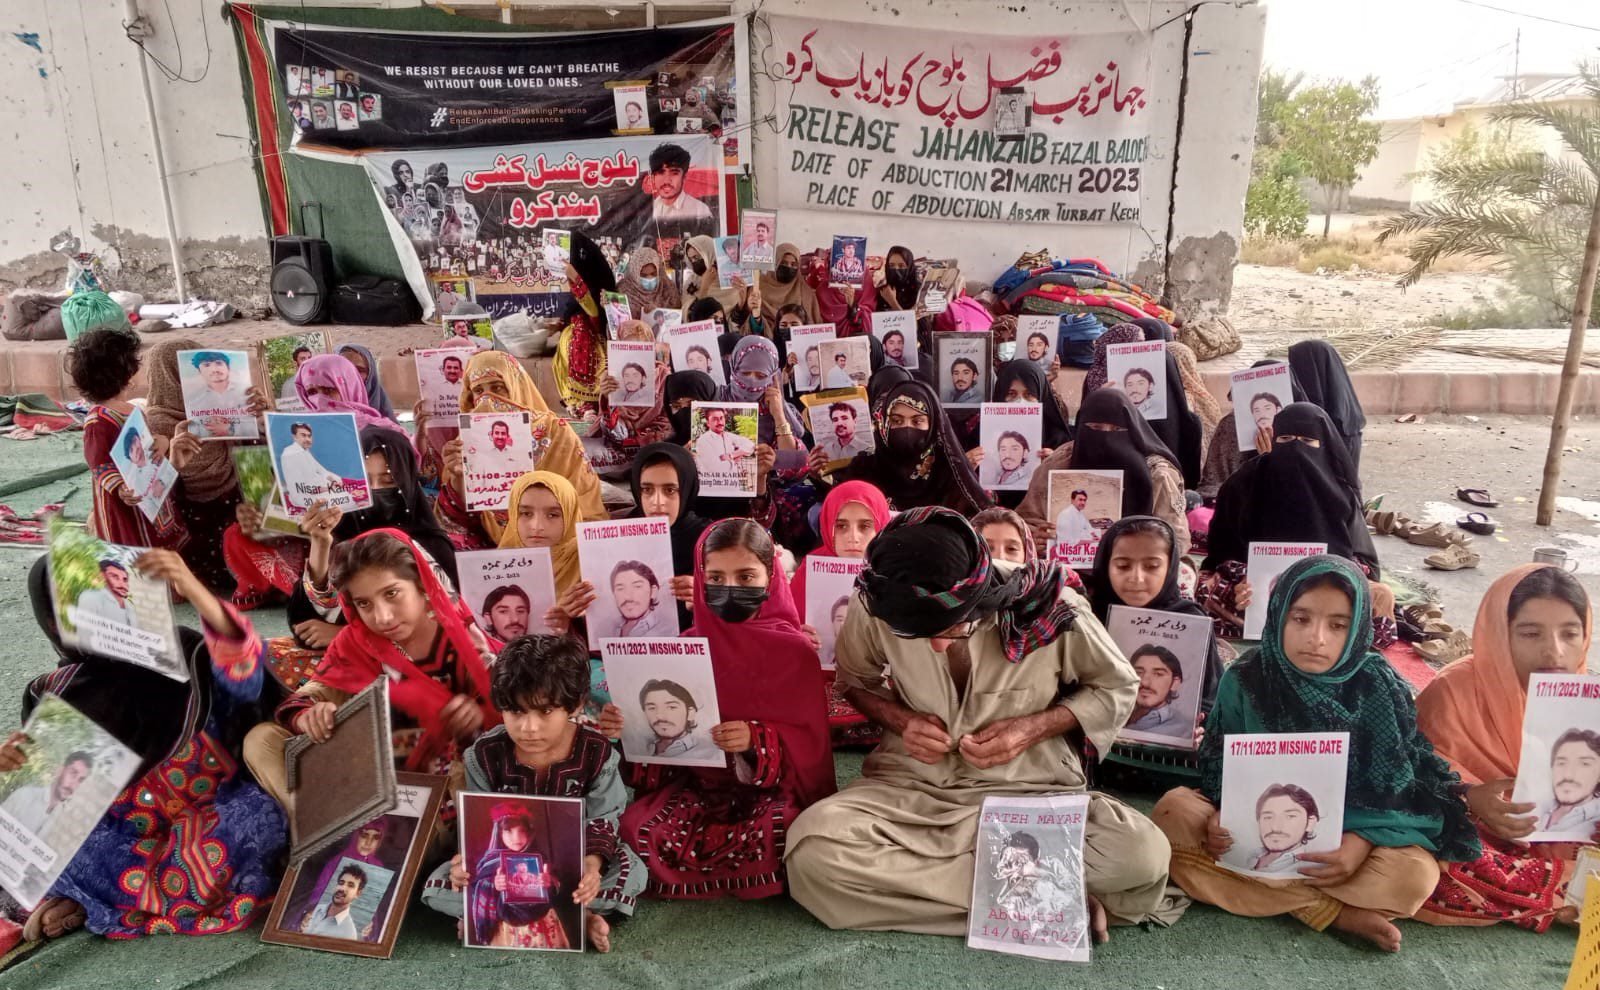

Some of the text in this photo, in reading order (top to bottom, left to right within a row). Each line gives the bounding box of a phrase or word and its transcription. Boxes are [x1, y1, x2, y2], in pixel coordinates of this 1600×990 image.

[785, 28, 818, 84] کرو
[384, 63, 620, 76] WE RESIST BECAUSE WE CAN'T BREATHE
[424, 77, 583, 89] WITHOUT OUR LOVED ONES.
[815, 51, 896, 108] بازیاب
[895, 51, 925, 106] کو
[916, 45, 966, 128] بلوچ
[957, 40, 1062, 119] فضل
[787, 104, 899, 153] RELEASE
[1050, 141, 1102, 165] FAZAL
[463, 149, 640, 192] بلوچ نسل کشی
[791, 150, 1140, 193] DATE OF ABDUCTION 21 MARCH 2023
[806, 182, 859, 207] PLACE
[872, 190, 894, 211] OF
[901, 194, 1002, 220] ABDUCTION
[509, 191, 601, 228] بند کرو
[1027, 407, 1039, 416] DATE
[469, 471, 533, 481] 11-08-20
[295, 482, 322, 494] Nisar
[330, 495, 350, 507] 2023
[583, 522, 667, 540] 17/11/2023 MISSING DATE
[1060, 543, 1081, 555] Nisar
[1283, 546, 1308, 556] MISSING
[1308, 547, 1323, 555] DATE
[813, 560, 846, 575] 17/11/2023
[606, 642, 705, 656] 17/11/2023 MISSING DATE
[1536, 681, 1580, 697] 17/11/2023
[1230, 740, 1343, 756] 17/11/2023 MISSING DATE
[1036, 813, 1082, 825] MAYAR
[987, 908, 1065, 923] Abuted
